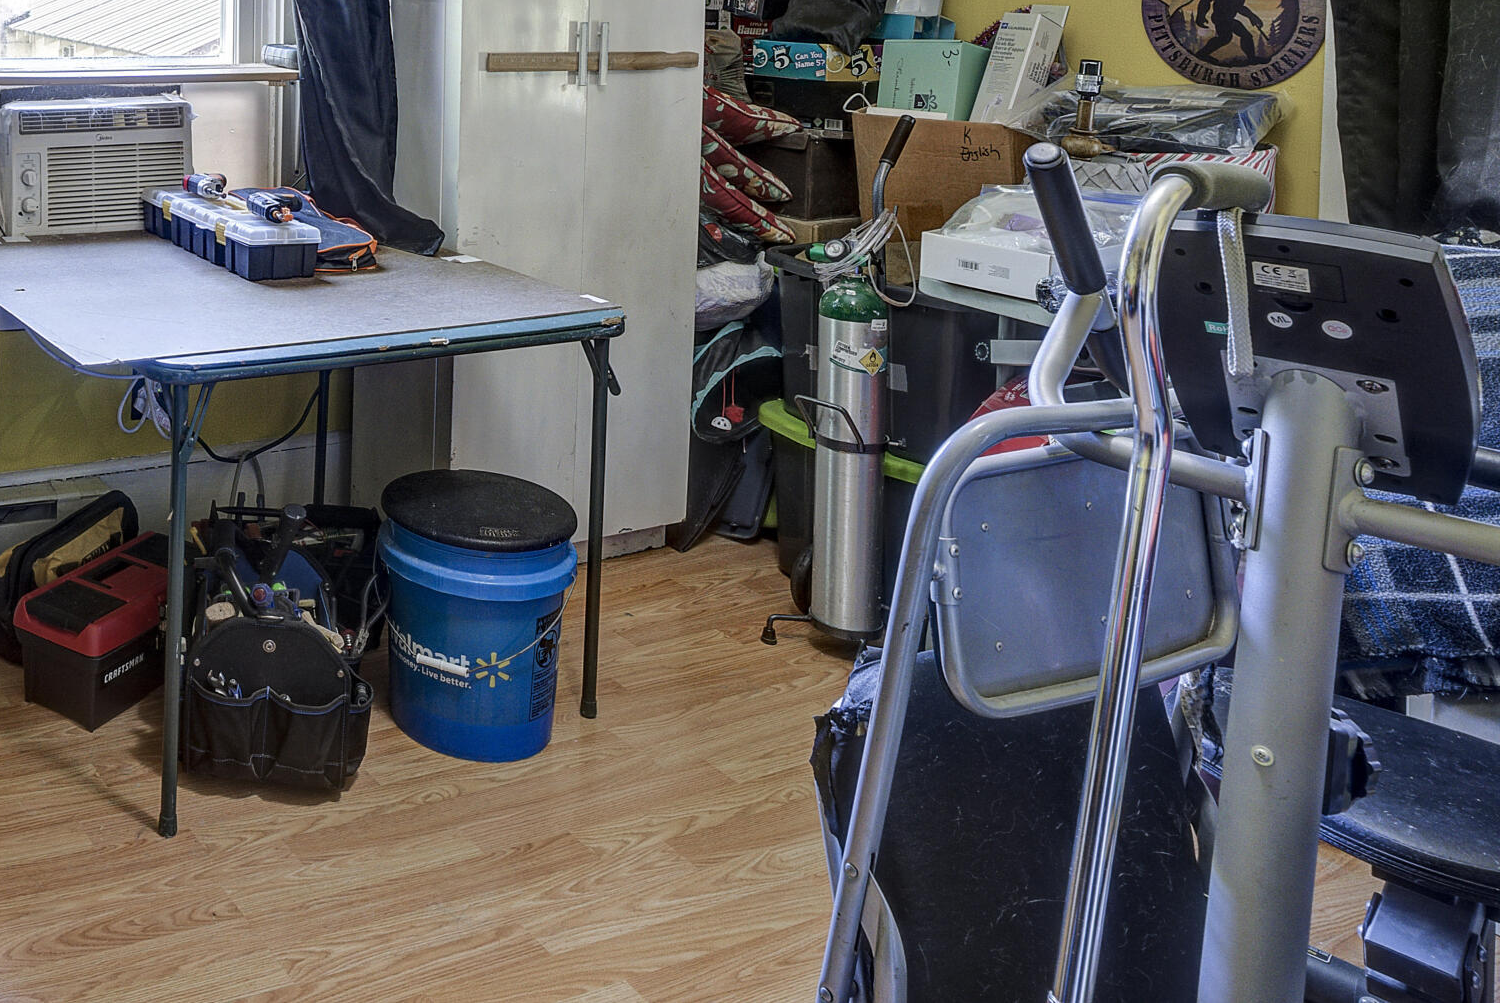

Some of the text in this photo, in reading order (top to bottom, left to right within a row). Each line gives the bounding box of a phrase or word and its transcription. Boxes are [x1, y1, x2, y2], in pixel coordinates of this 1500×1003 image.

[737, 24, 769, 36] Bauer
[773, 46, 791, 69] 5
[794, 51, 823, 61] Can You
[1147, 13, 1320, 88] PITTSBURGH STEELERS
[794, 59, 826, 69] Name 5?
[851, 52, 868, 76] 5
[963, 126, 972, 146] K
[1208, 323, 1230, 333] RoH
[1270, 315, 1291, 325] ML
[103, 652, 145, 684] CRAFTSMAN
[421, 665, 439, 681] Live
[440, 672, 473, 690] better.
